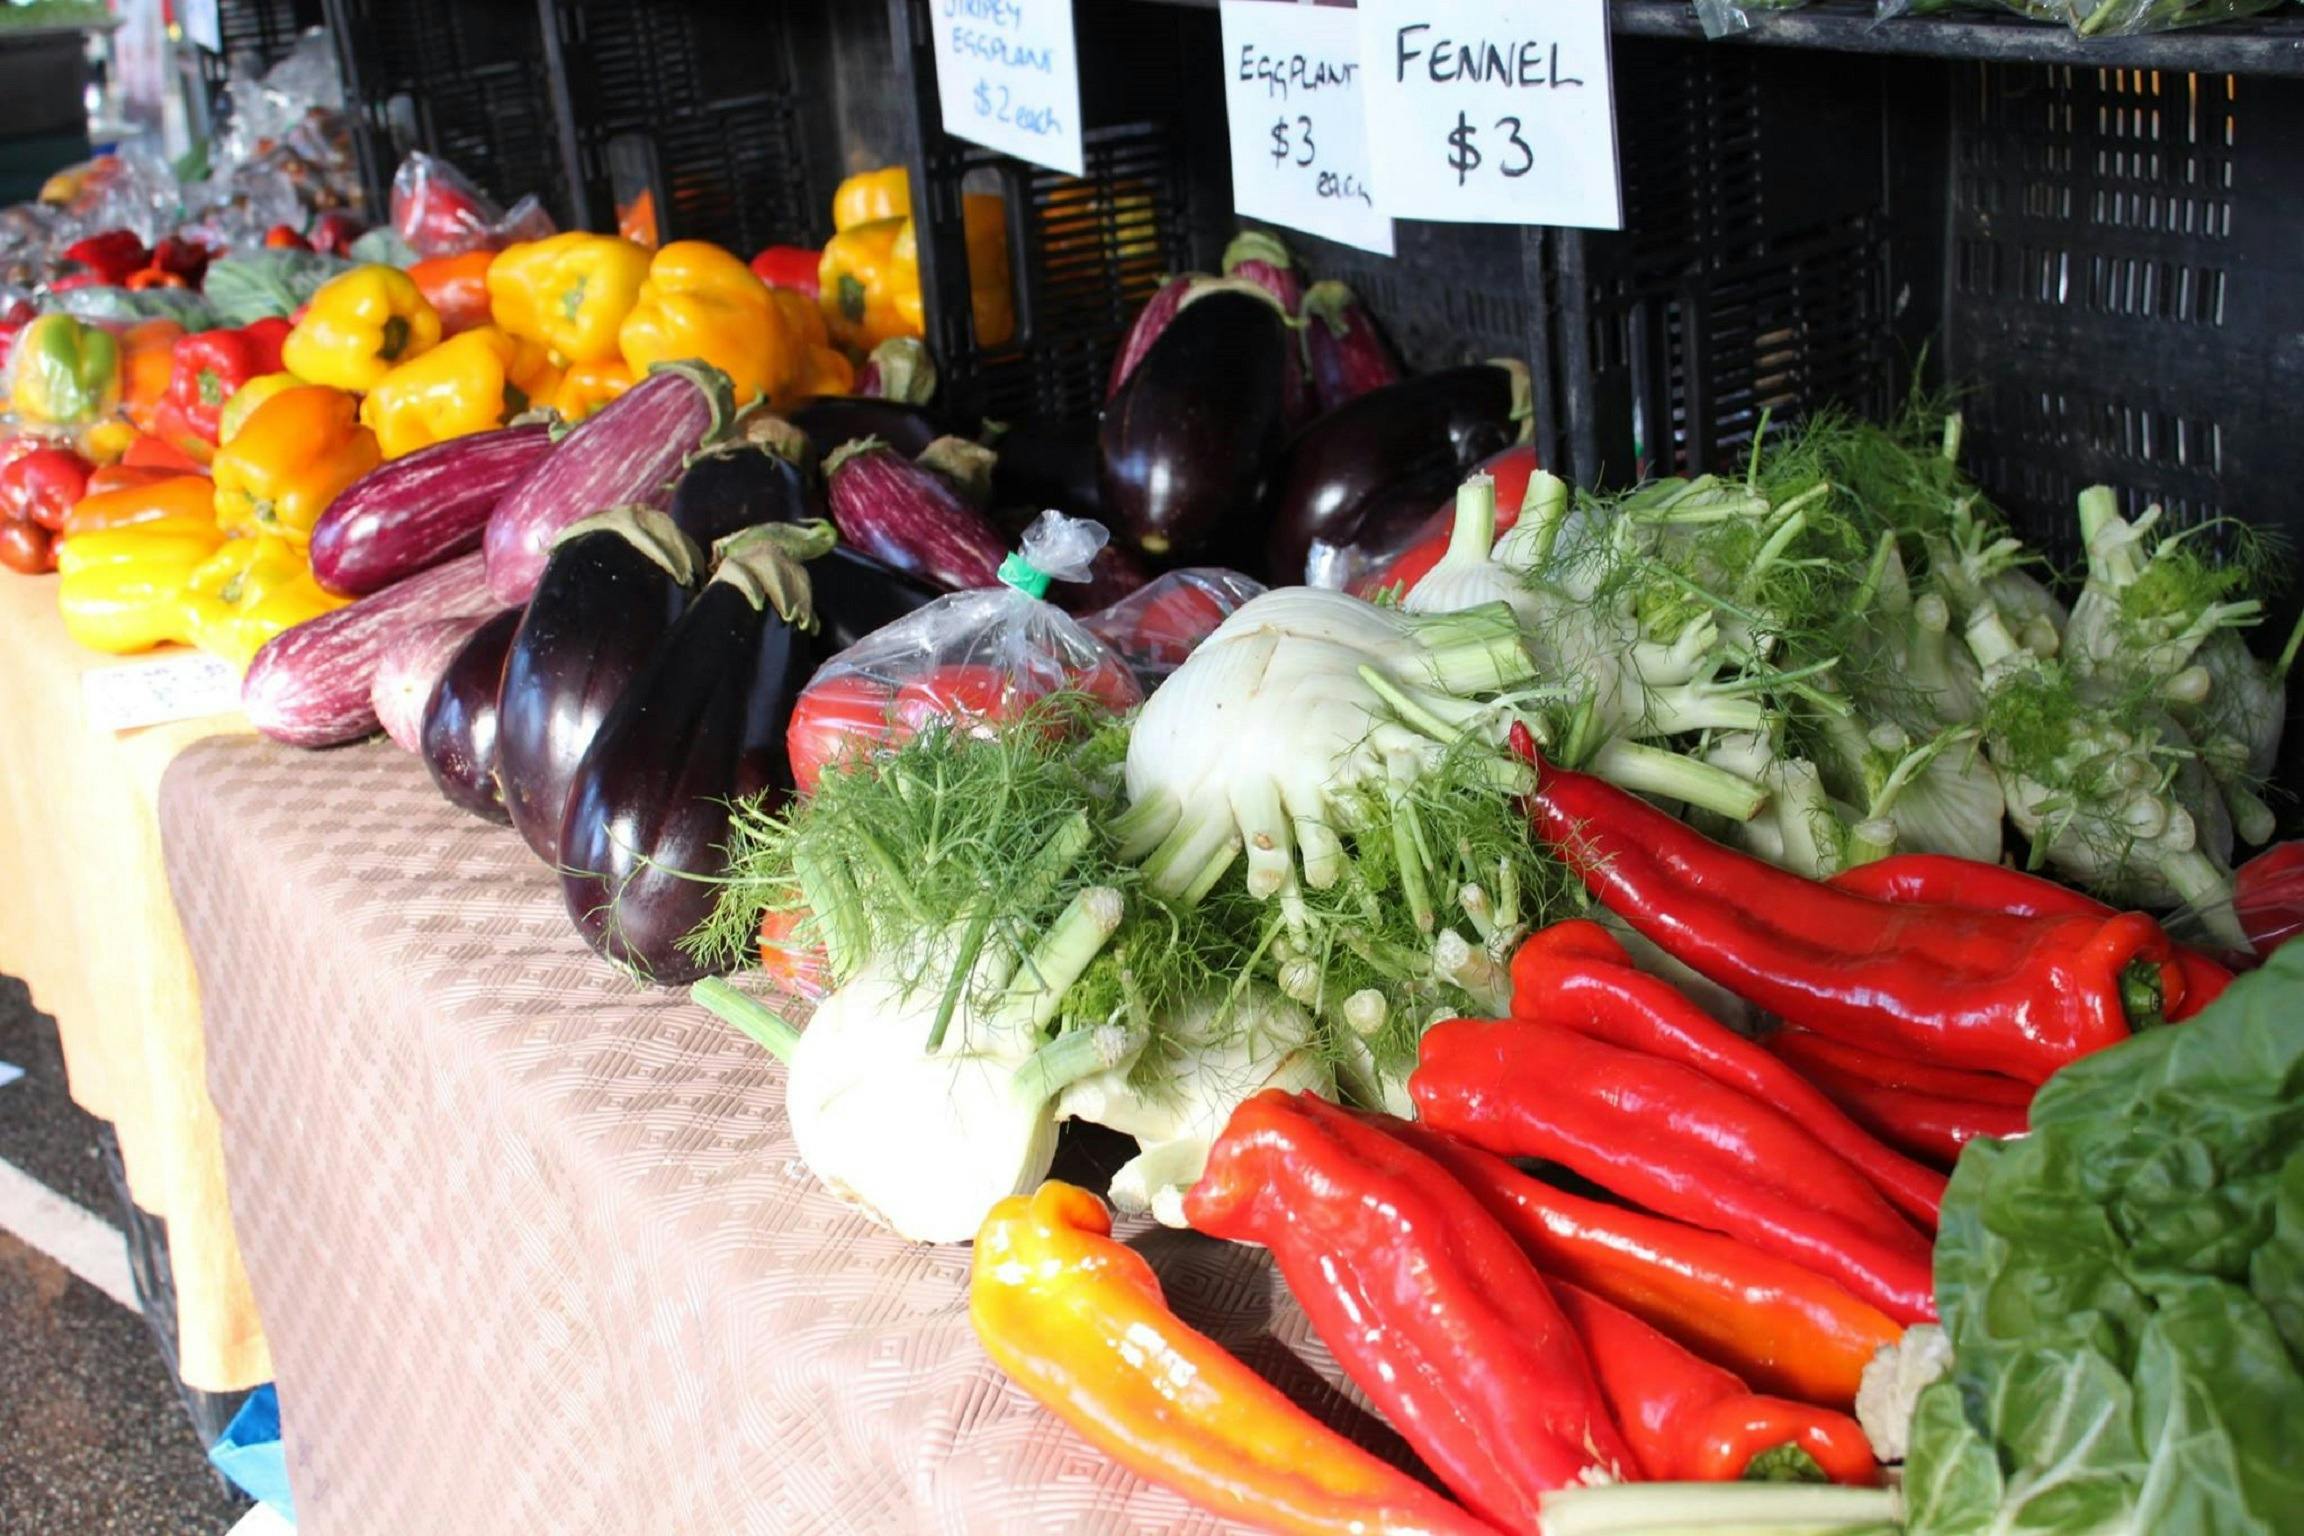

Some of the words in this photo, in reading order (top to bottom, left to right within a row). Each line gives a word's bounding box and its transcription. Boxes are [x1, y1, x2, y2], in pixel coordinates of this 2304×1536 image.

[953, 26, 1054, 75] EGGPLANT
[1239, 44, 1360, 101] EGGPLANT
[1396, 23, 1585, 90] FENNEL
[973, 78, 1010, 123] $2
[1015, 106, 1063, 136] each
[1270, 115, 1315, 170] $3
[1447, 109, 1534, 187] $3
[1316, 170, 1372, 208] each
